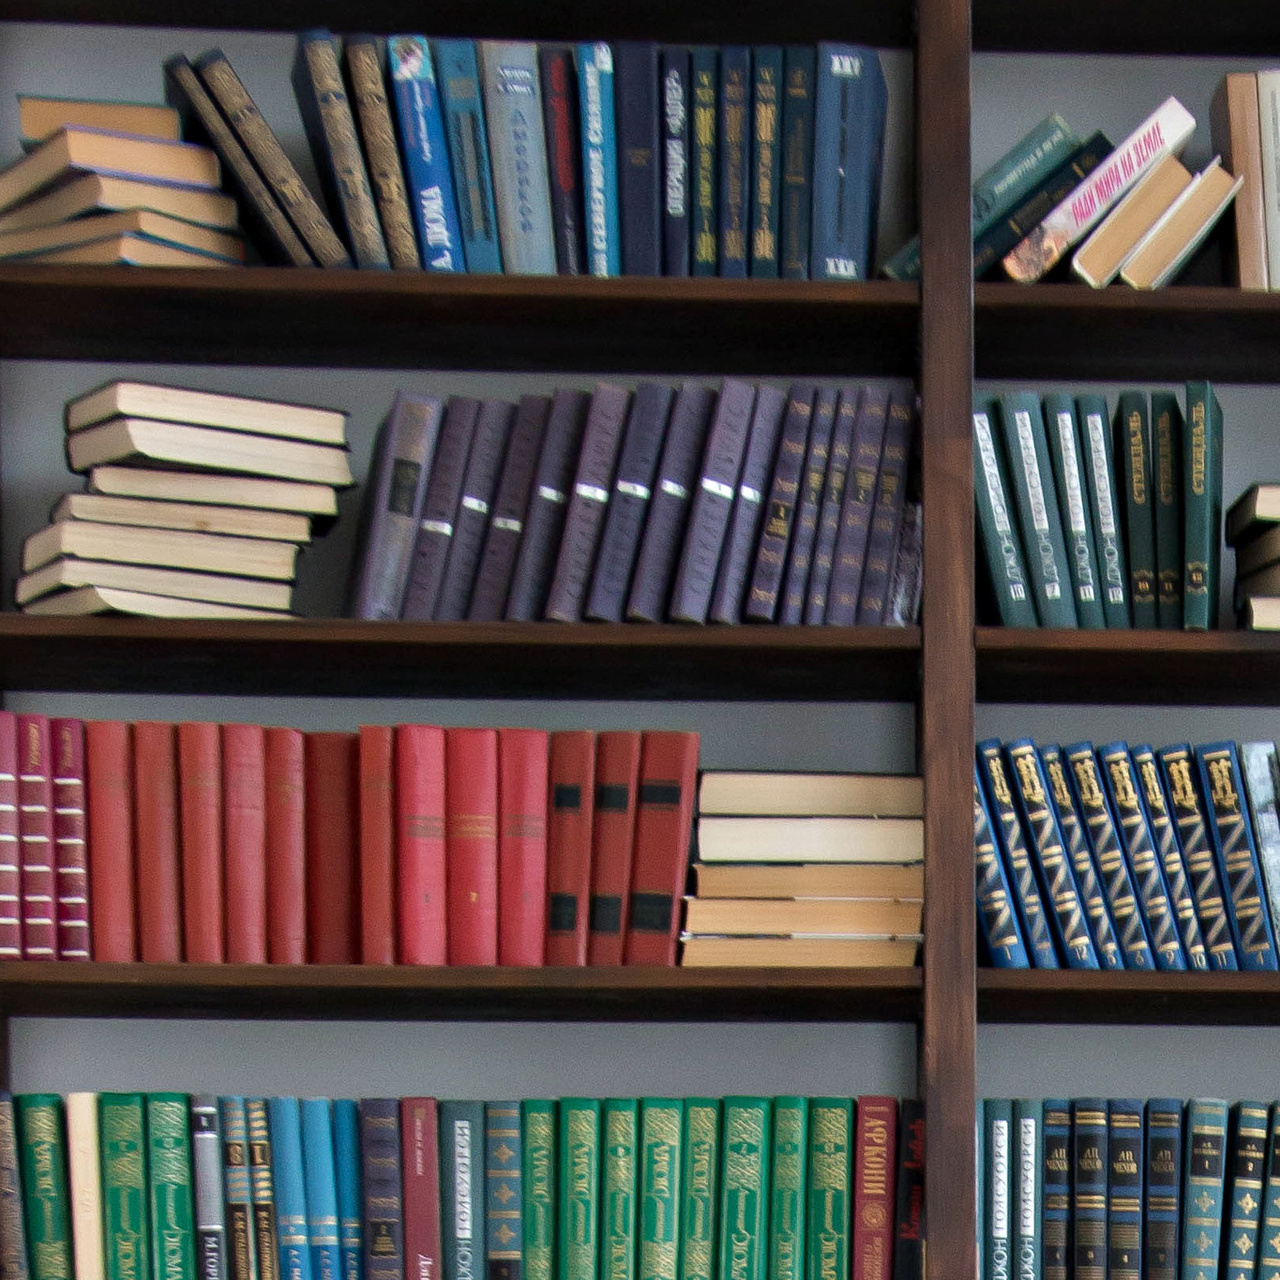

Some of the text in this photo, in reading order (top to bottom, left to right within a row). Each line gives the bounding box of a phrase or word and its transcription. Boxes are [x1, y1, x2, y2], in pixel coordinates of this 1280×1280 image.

[419, 185, 451, 247] ДЮМА
[1129, 411, 1146, 505] СТЕНДАЛЬ
[1191, 402, 1206, 495] СТЕНДАЛЬ
[993, 1120, 1008, 1238] ГОЛСУОРСИ
[1020, 1118, 1035, 1236] ГОЛСУОРСИ
